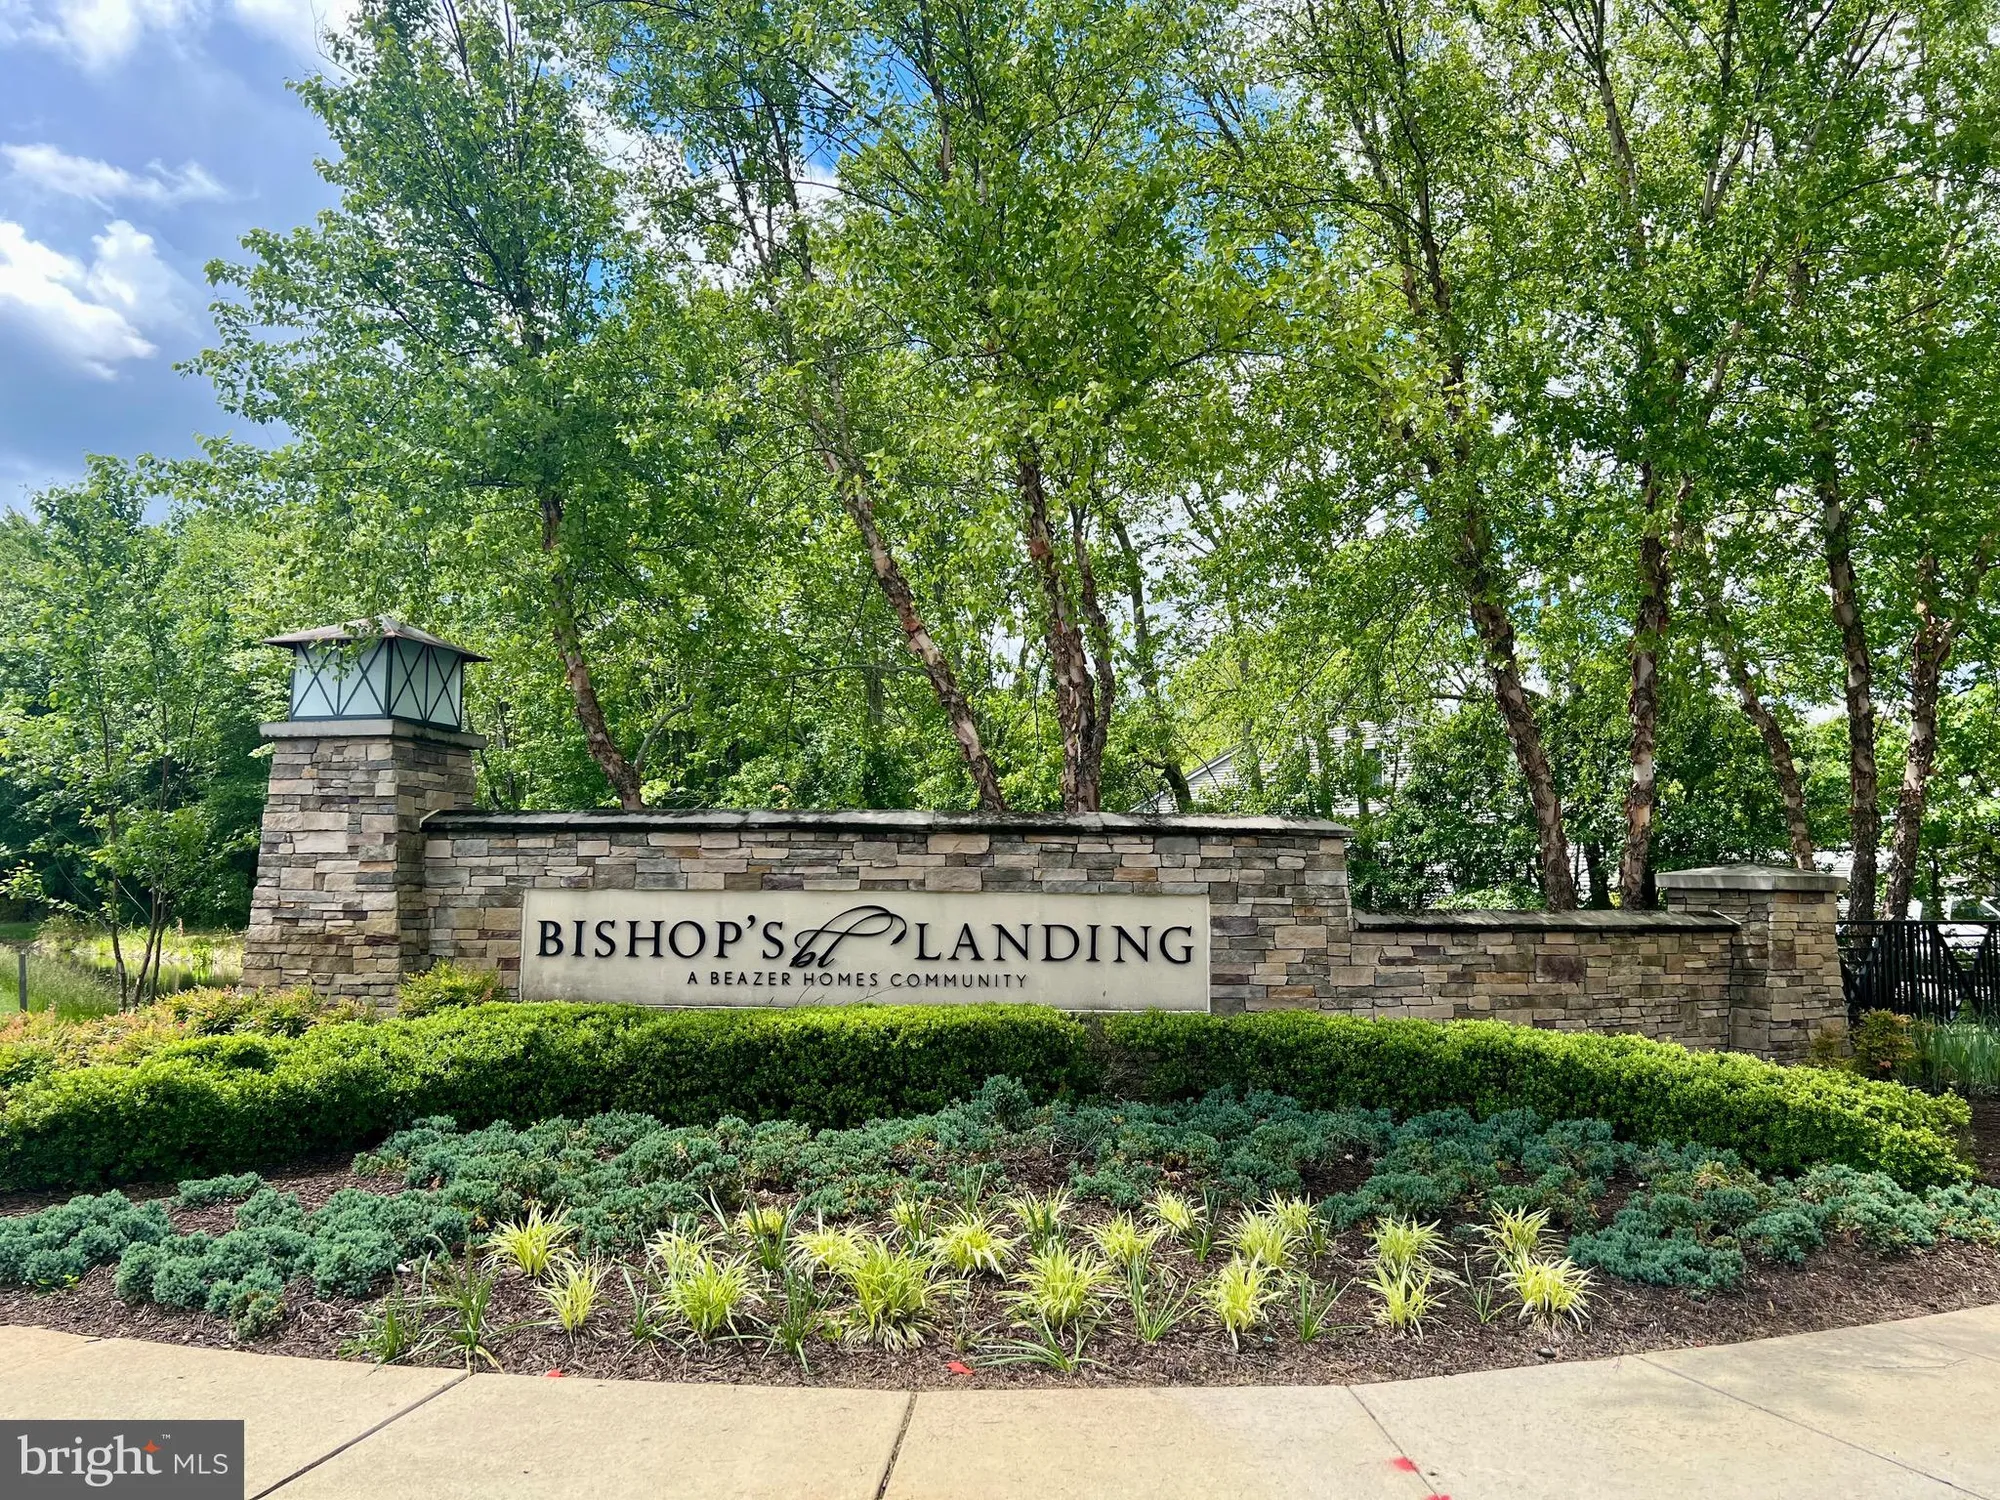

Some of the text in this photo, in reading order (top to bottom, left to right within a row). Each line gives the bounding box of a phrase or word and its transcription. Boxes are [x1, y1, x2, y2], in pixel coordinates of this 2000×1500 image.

[536, 914, 785, 960] BISHOP'S
[914, 922, 1195, 965] LANDING
[687, 971, 1027, 988] A BEAZER HOMES COMMUNITY
